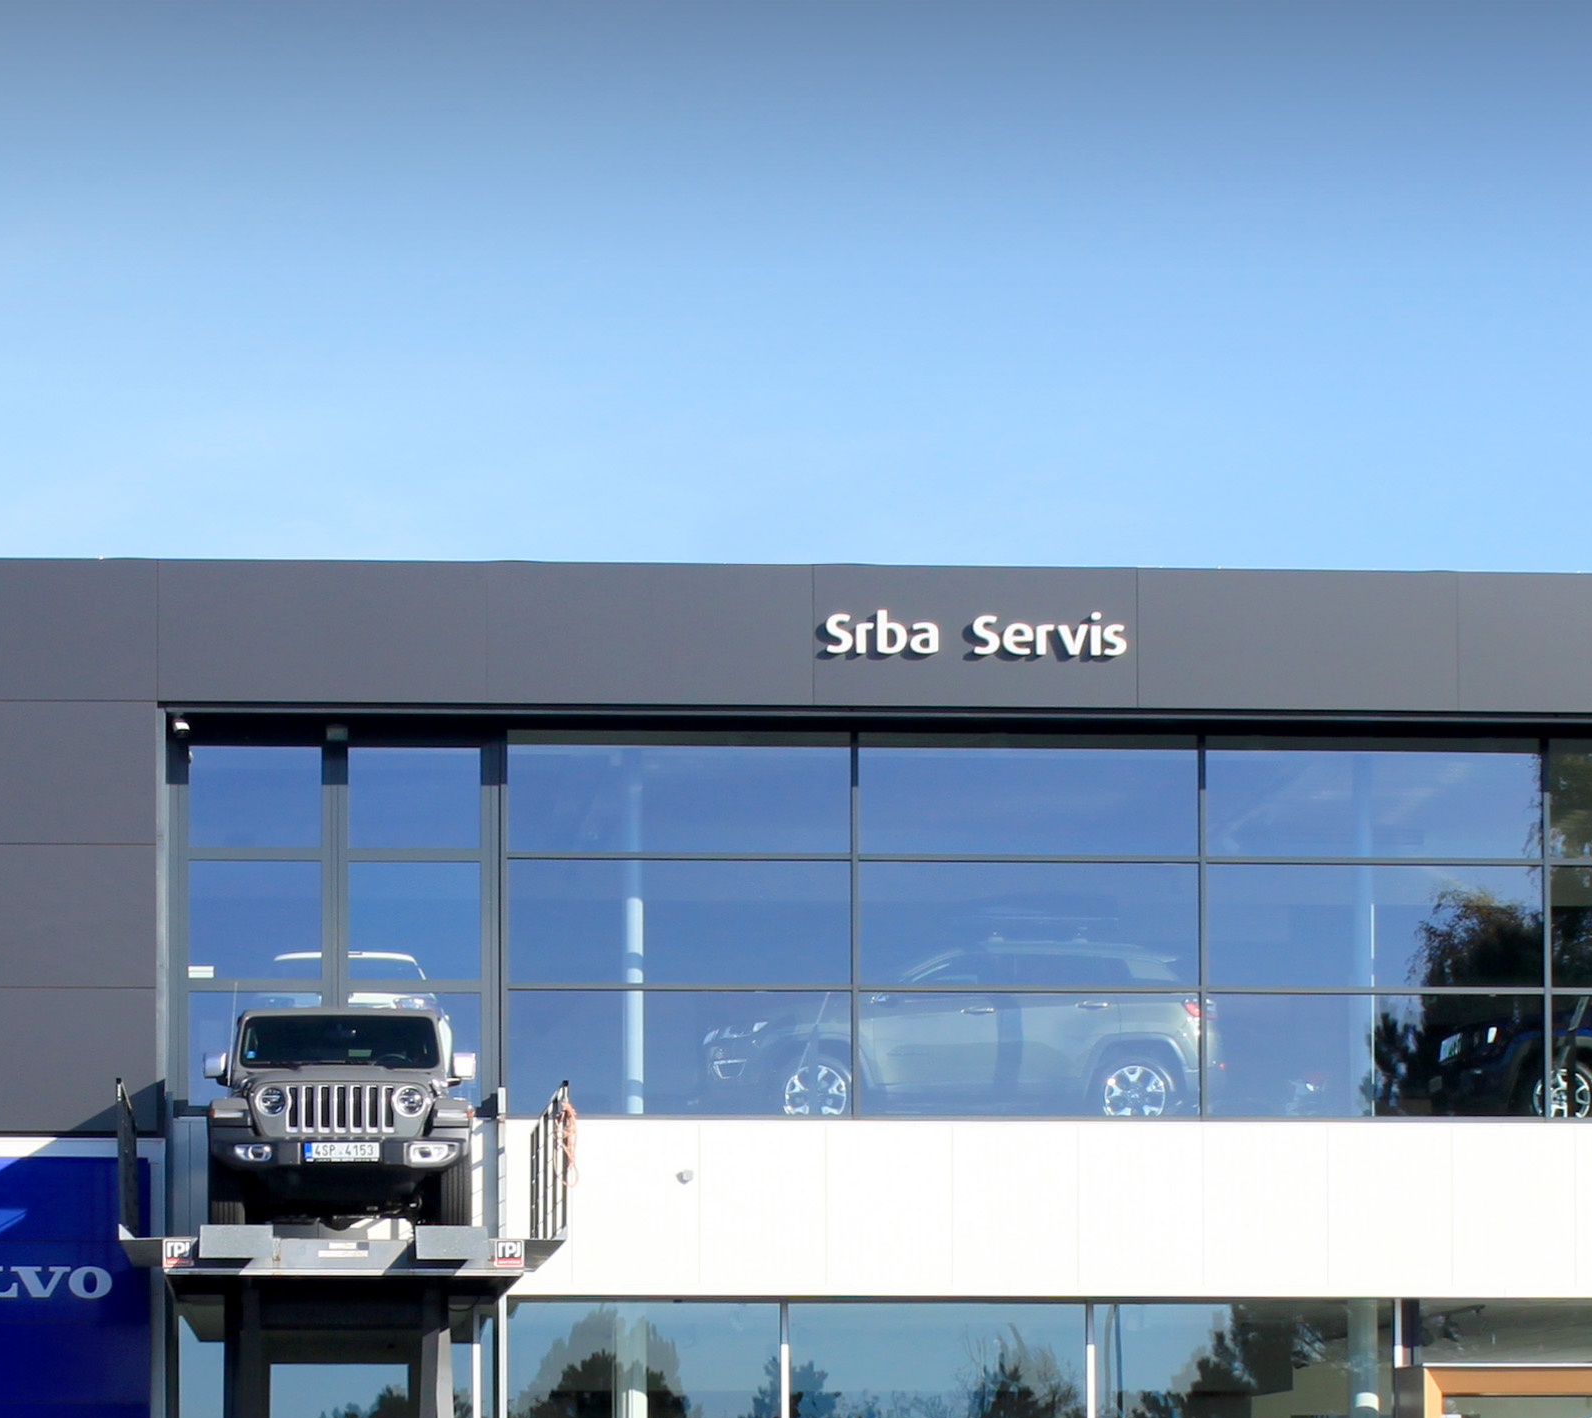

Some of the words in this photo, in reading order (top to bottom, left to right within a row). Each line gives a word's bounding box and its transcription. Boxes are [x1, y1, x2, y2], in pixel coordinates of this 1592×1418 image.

[825, 609, 940, 655] Srba
[972, 611, 1127, 657] Servis
[315, 1144, 336, 1156] 4SP
[345, 1144, 374, 1156] 4153
